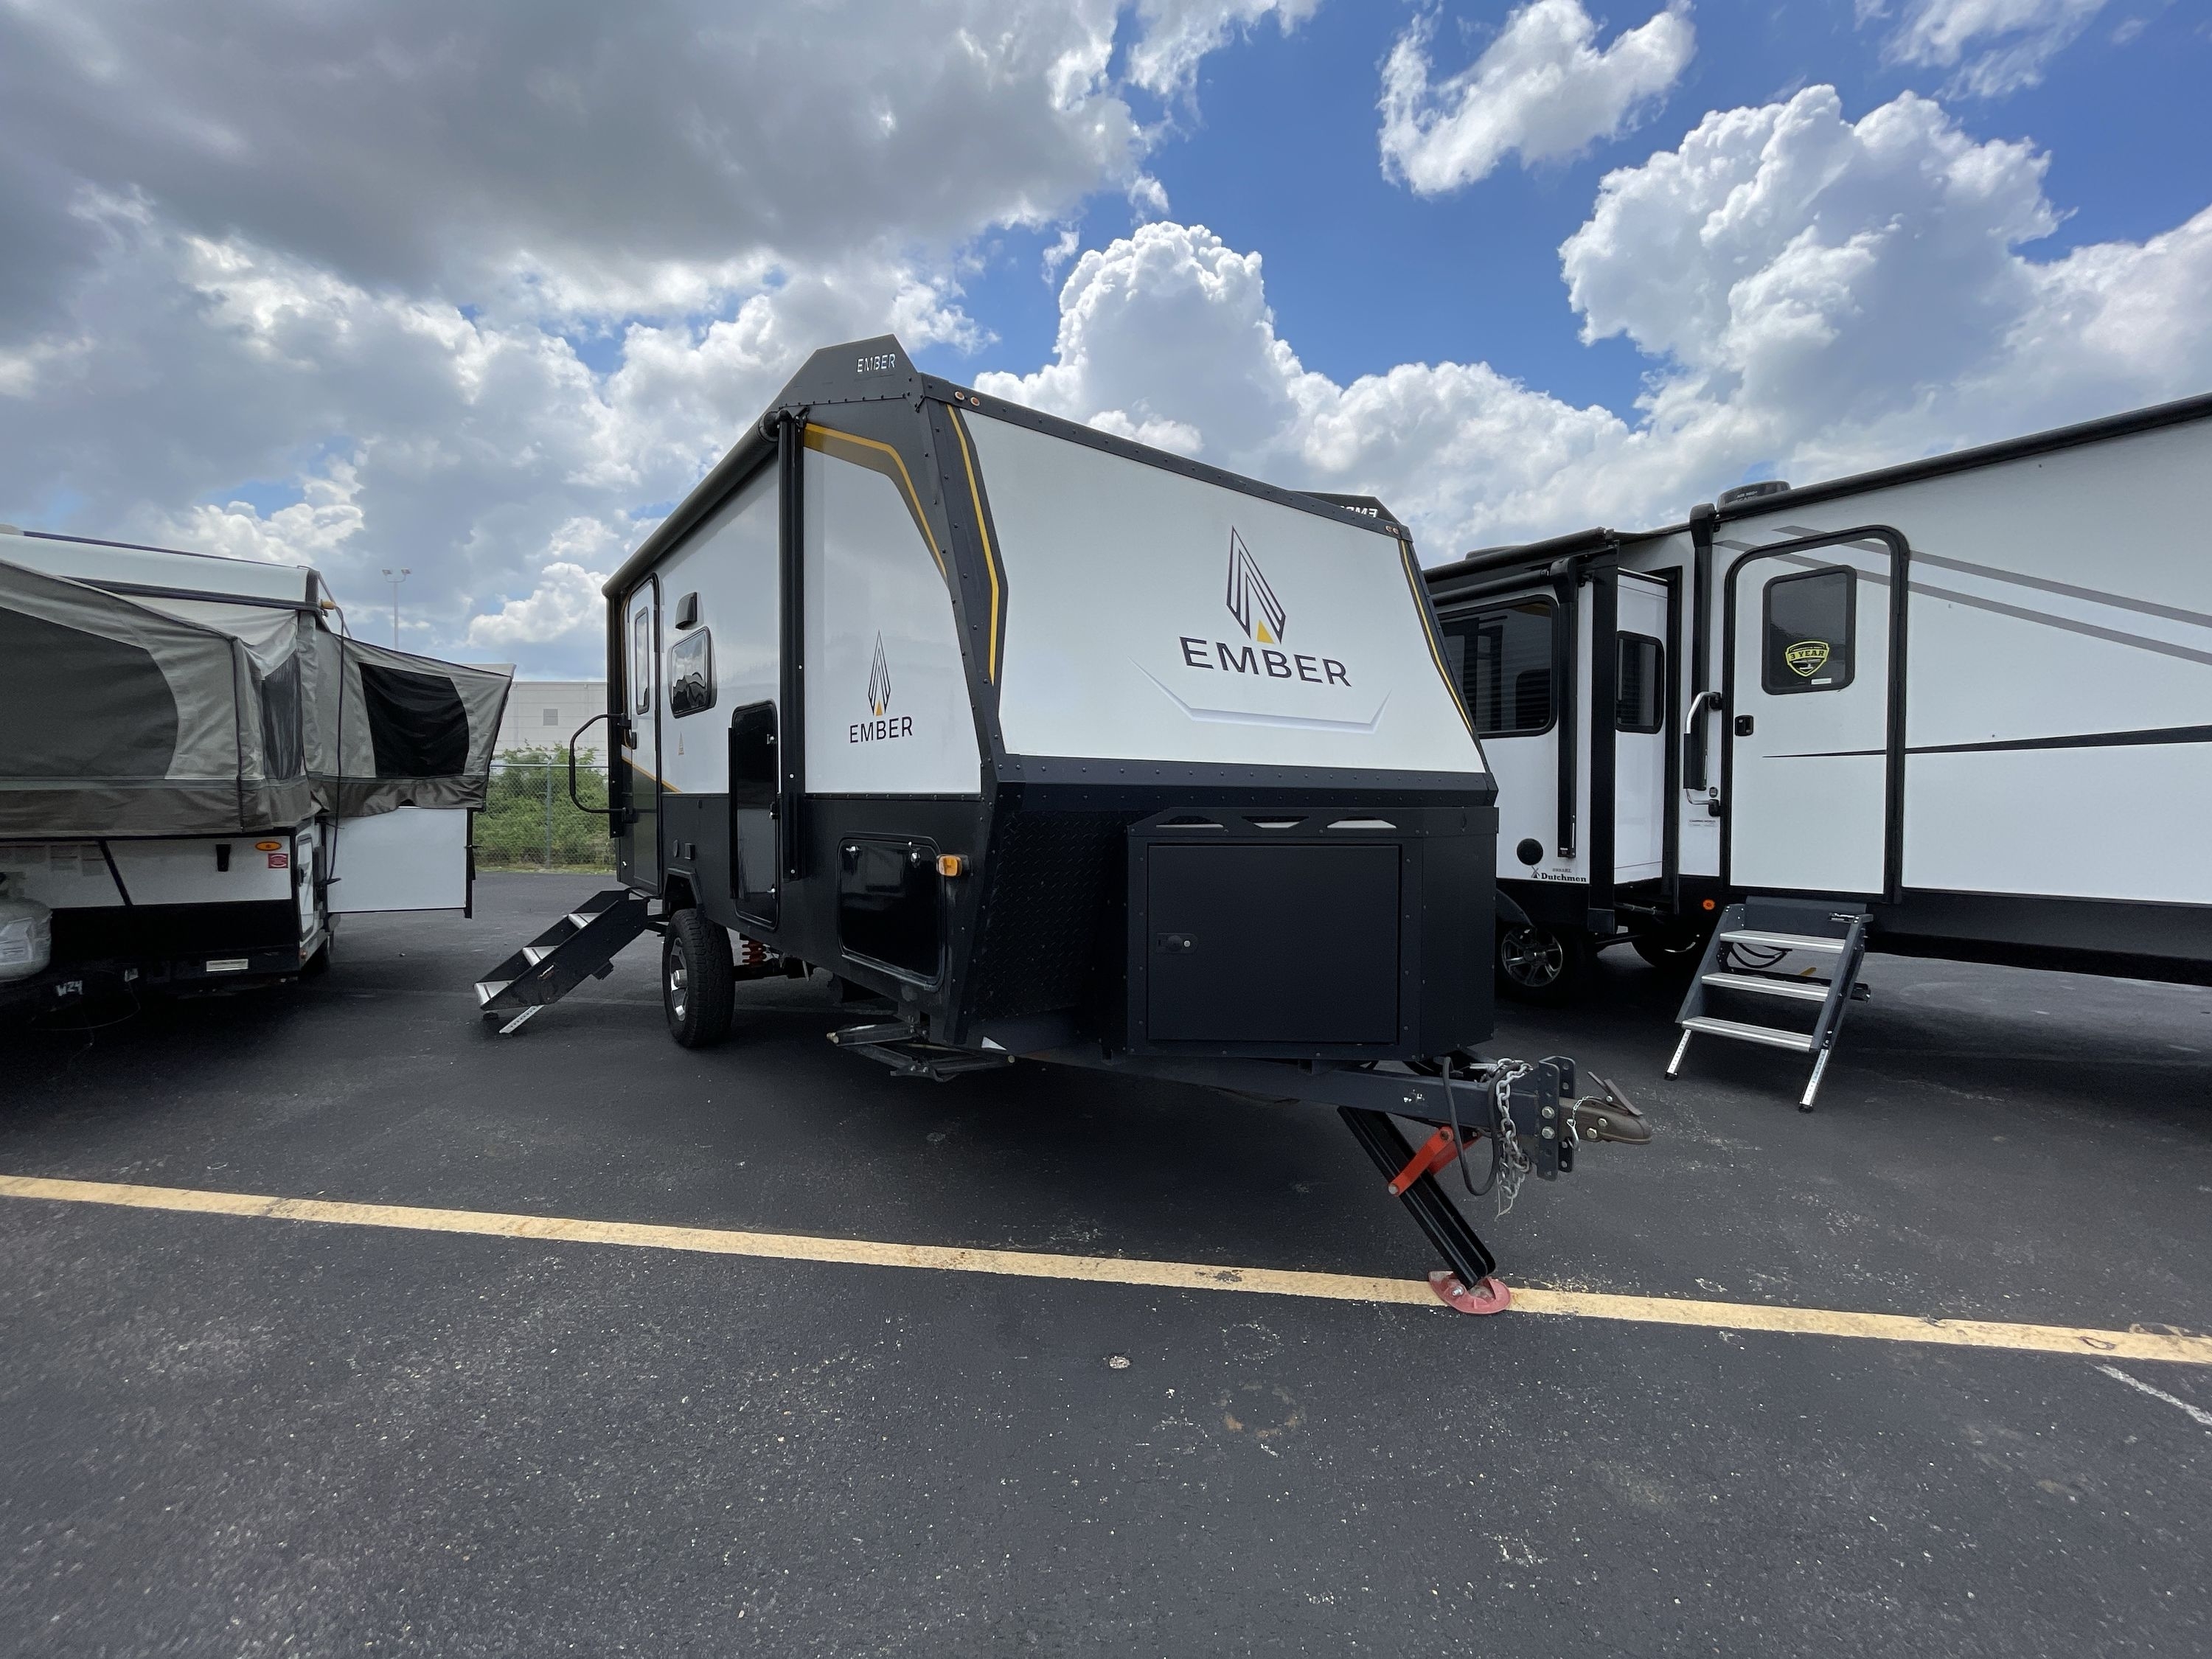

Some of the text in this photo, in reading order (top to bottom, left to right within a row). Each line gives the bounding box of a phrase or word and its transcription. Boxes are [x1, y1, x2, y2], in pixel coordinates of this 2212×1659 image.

[857, 353, 896, 372] EMBER
[1179, 636, 1352, 688] EMBER
[849, 716, 913, 743] EMBER
[1541, 872, 1587, 883] Dutchmen
